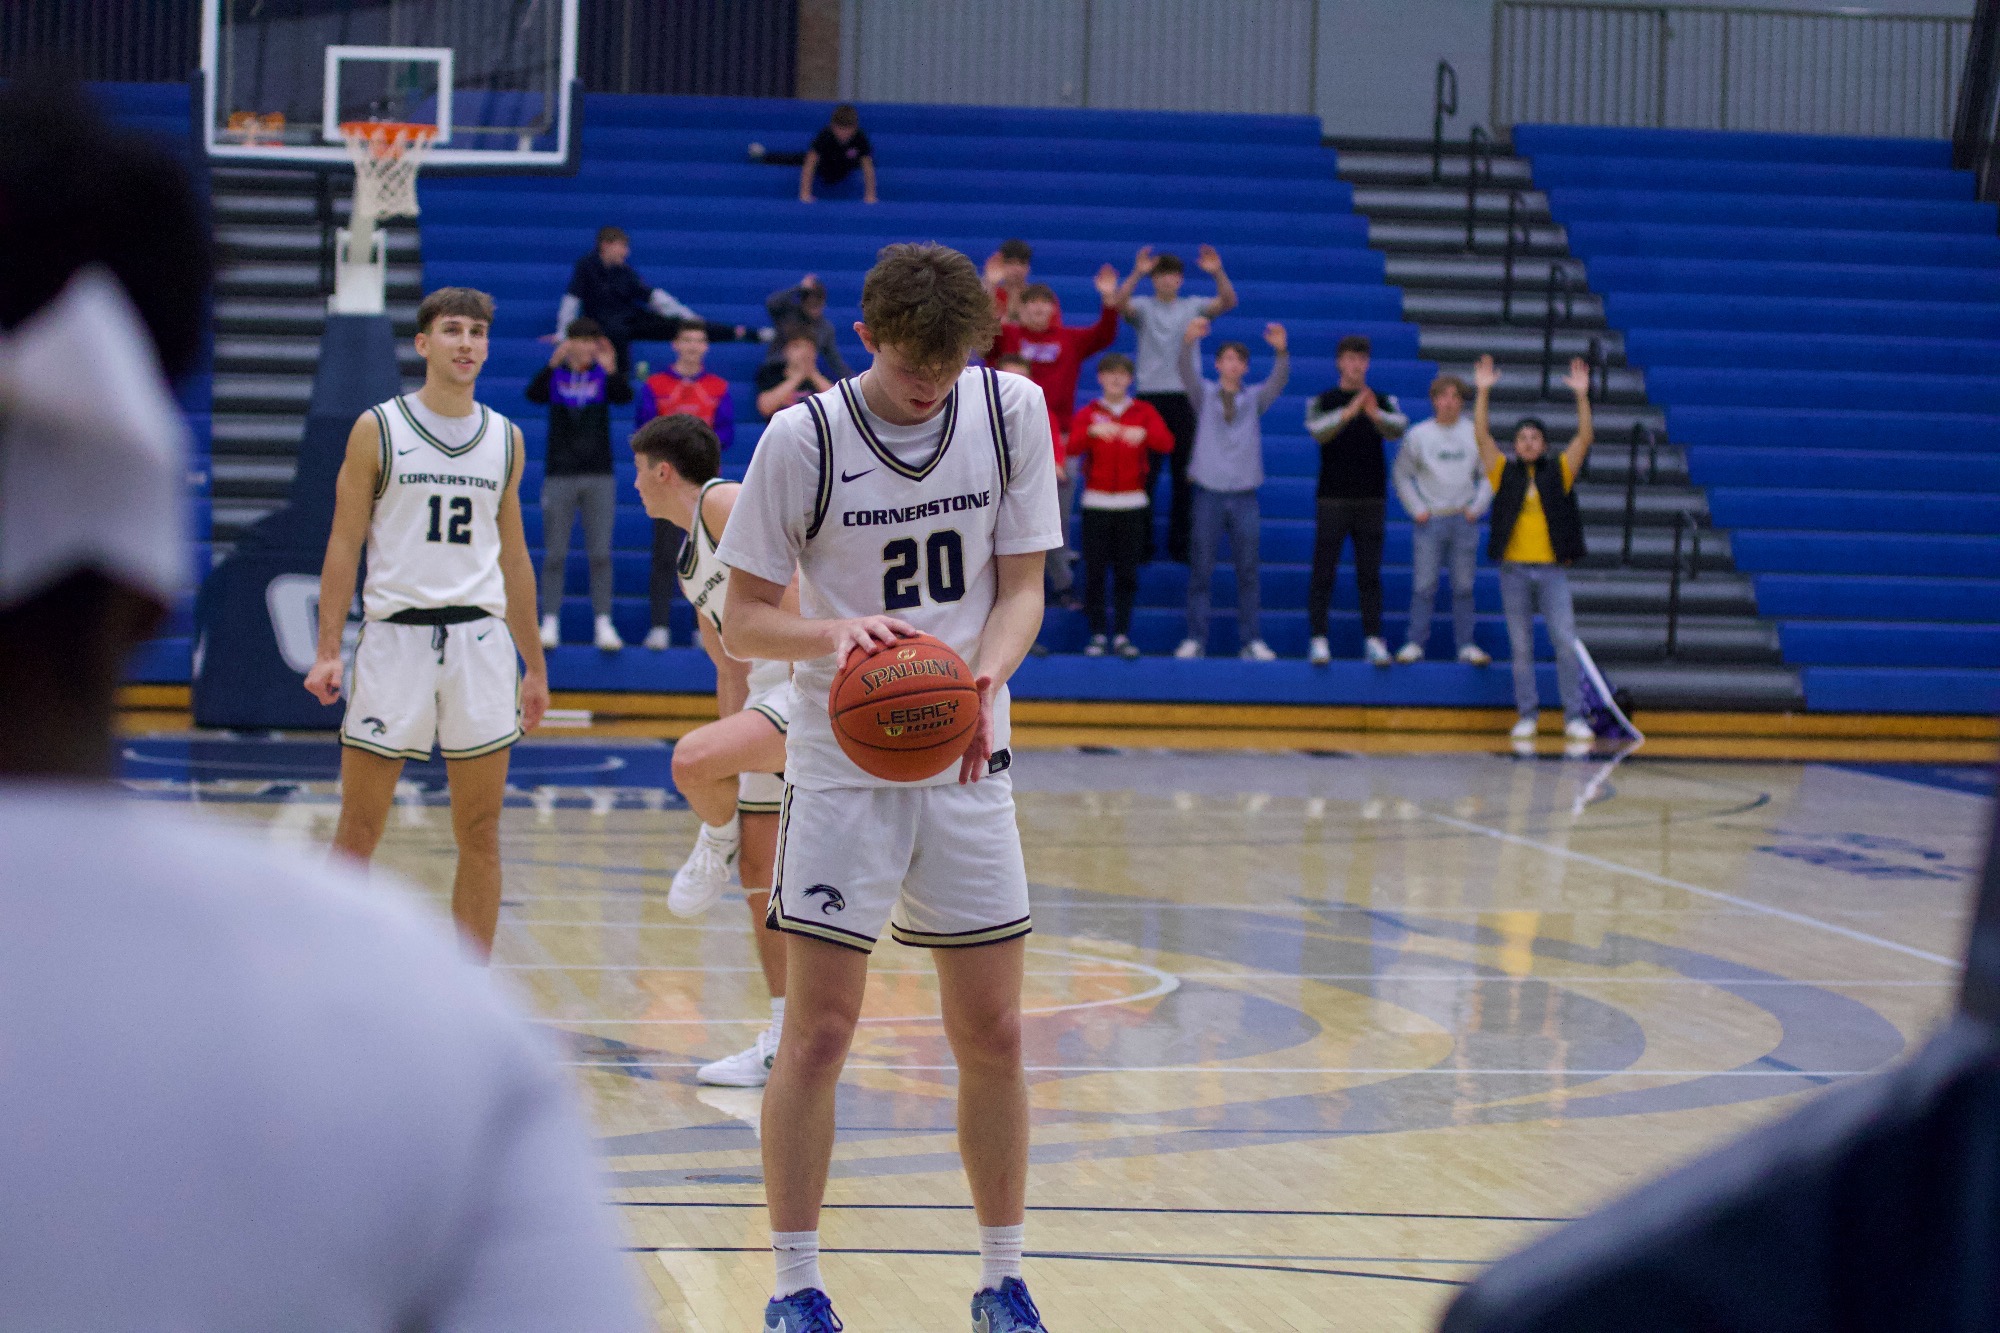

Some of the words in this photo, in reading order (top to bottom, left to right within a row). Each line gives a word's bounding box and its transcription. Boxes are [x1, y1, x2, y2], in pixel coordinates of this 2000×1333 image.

[399, 473, 498, 491] CORNERSTONE
[426, 494, 472, 545] 12
[842, 490, 990, 527] CORNERSTONE
[882, 528, 967, 613] 20
[861, 659, 959, 696] SPALDING
[876, 699, 959, 726] LEGACY
